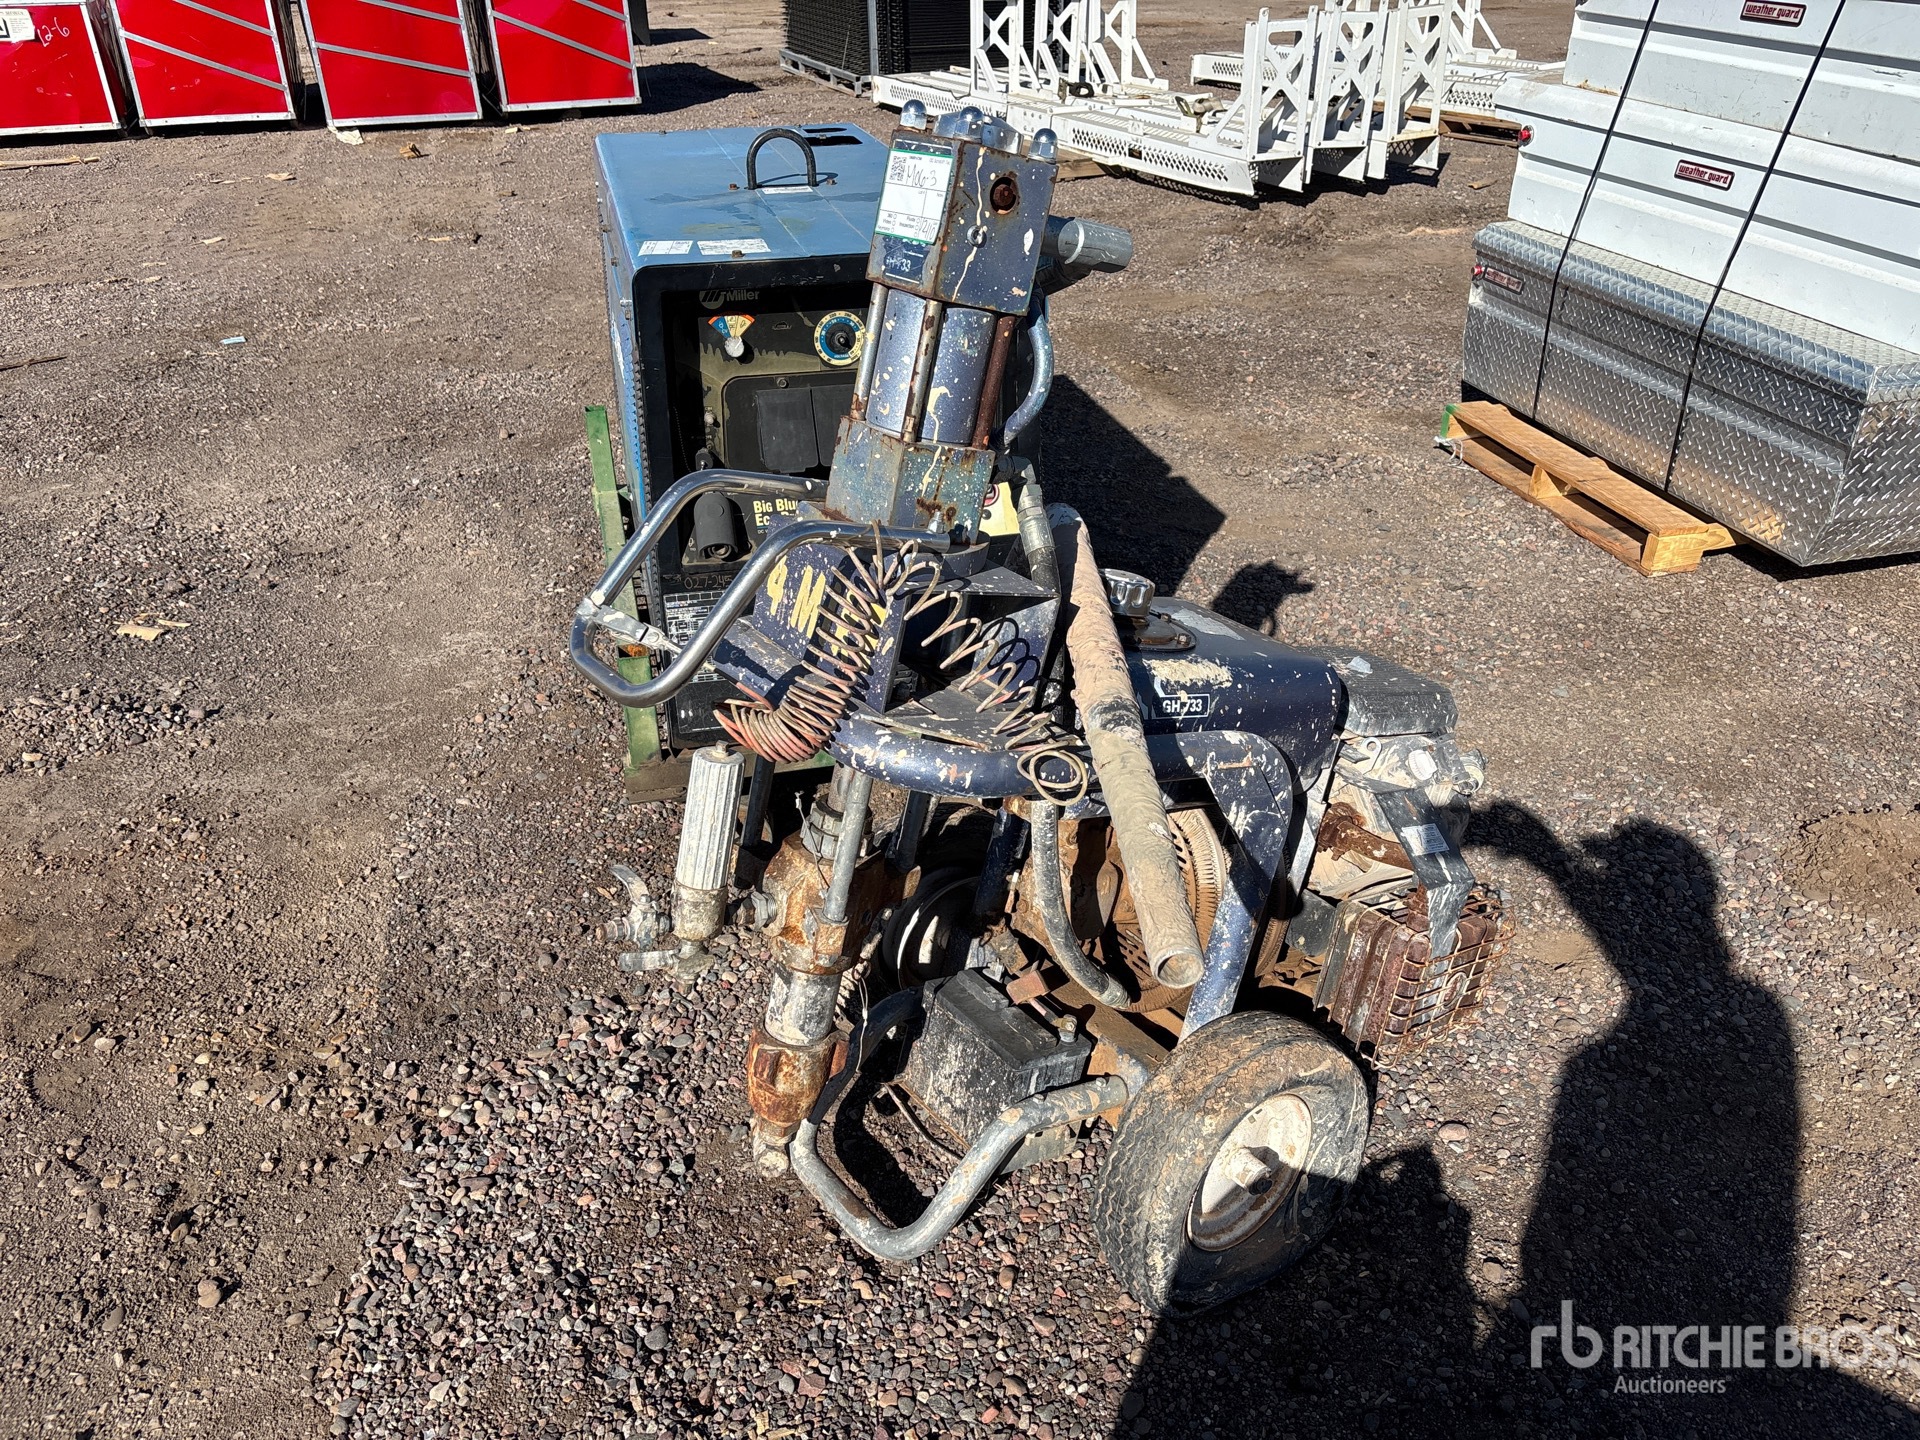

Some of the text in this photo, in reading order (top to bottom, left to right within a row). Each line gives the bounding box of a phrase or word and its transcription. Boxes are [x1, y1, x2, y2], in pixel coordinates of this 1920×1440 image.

[1746, 4, 1801, 19] weather guard
[1679, 165, 1729, 184] weather guard
[726, 289, 760, 302] Miller
[775, 498, 799, 511] Blu
